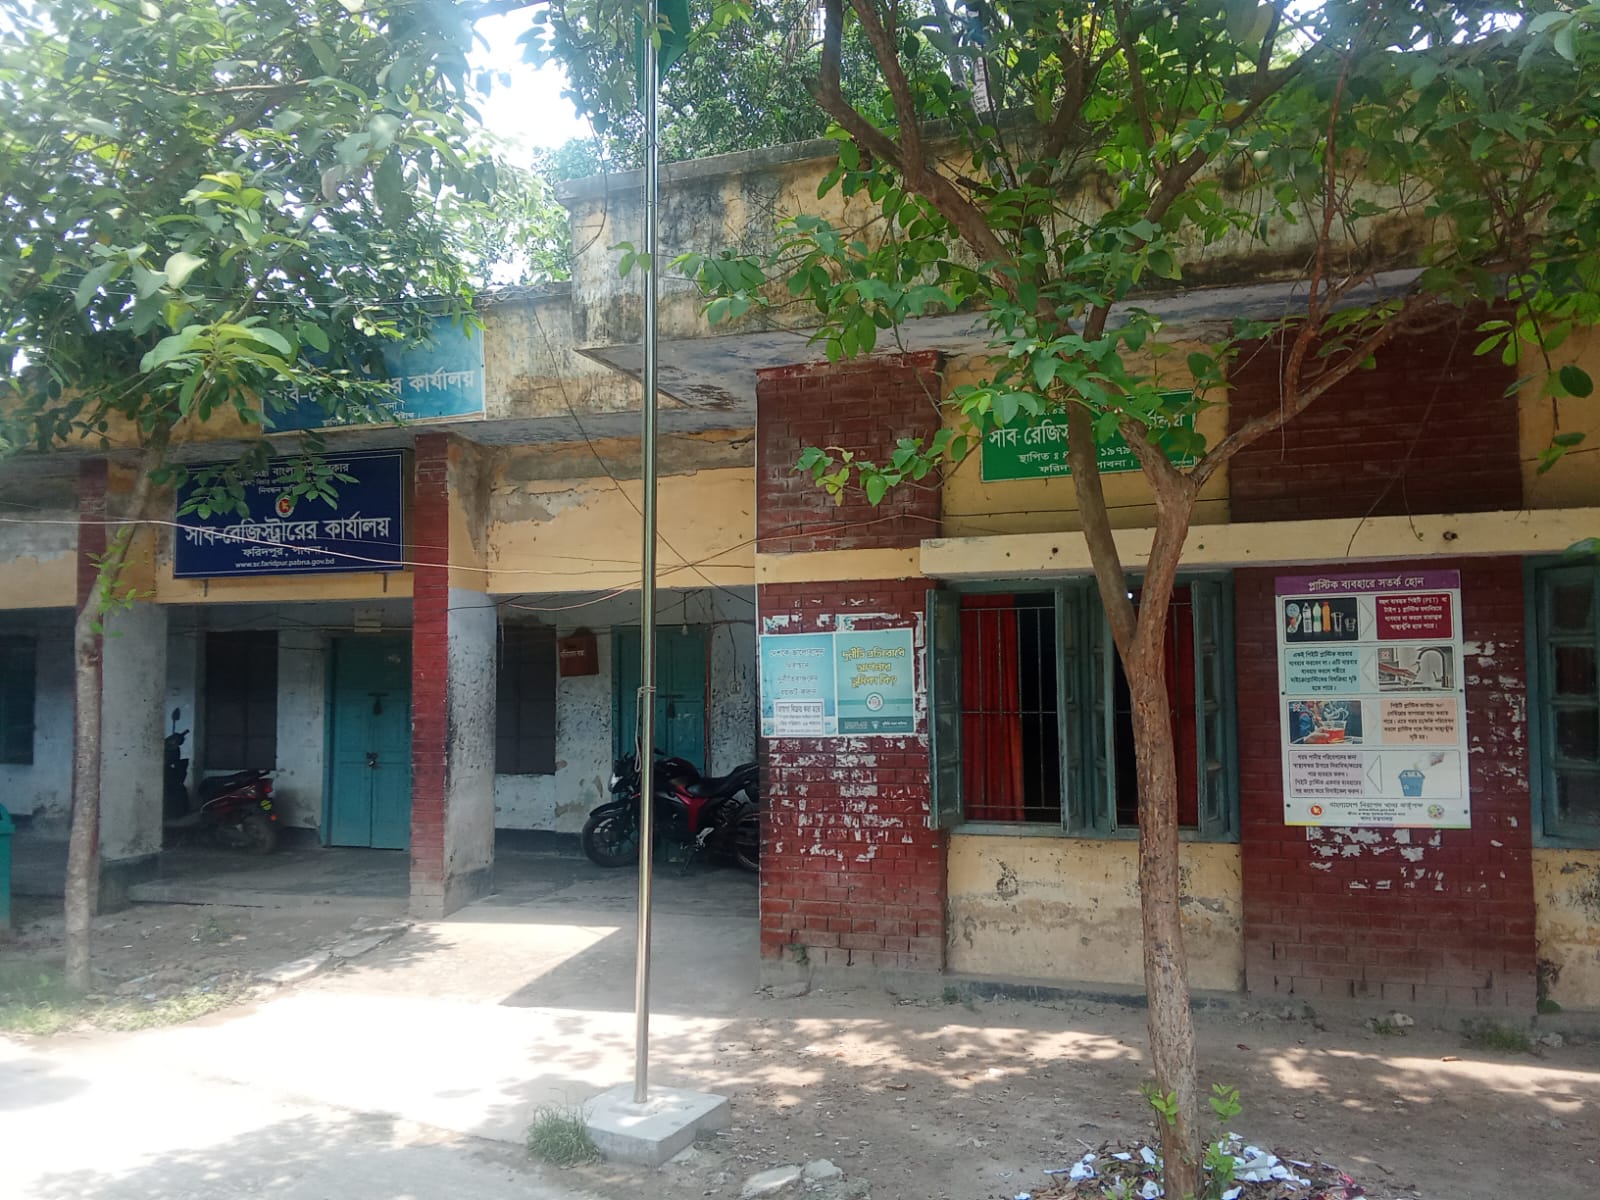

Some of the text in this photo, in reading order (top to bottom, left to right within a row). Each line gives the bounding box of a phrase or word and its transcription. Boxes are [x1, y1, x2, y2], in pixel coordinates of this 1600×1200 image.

[409, 366, 476, 393] কার্যালয়
[1017, 451, 1050, 464] স্থাপিত
[184, 511, 392, 547] সাব-রেজিস্ট্রারের কার্যালয়
[1308, 574, 1424, 591] প্লাস্টিক ব্যবহারে সতর্ক হোন
